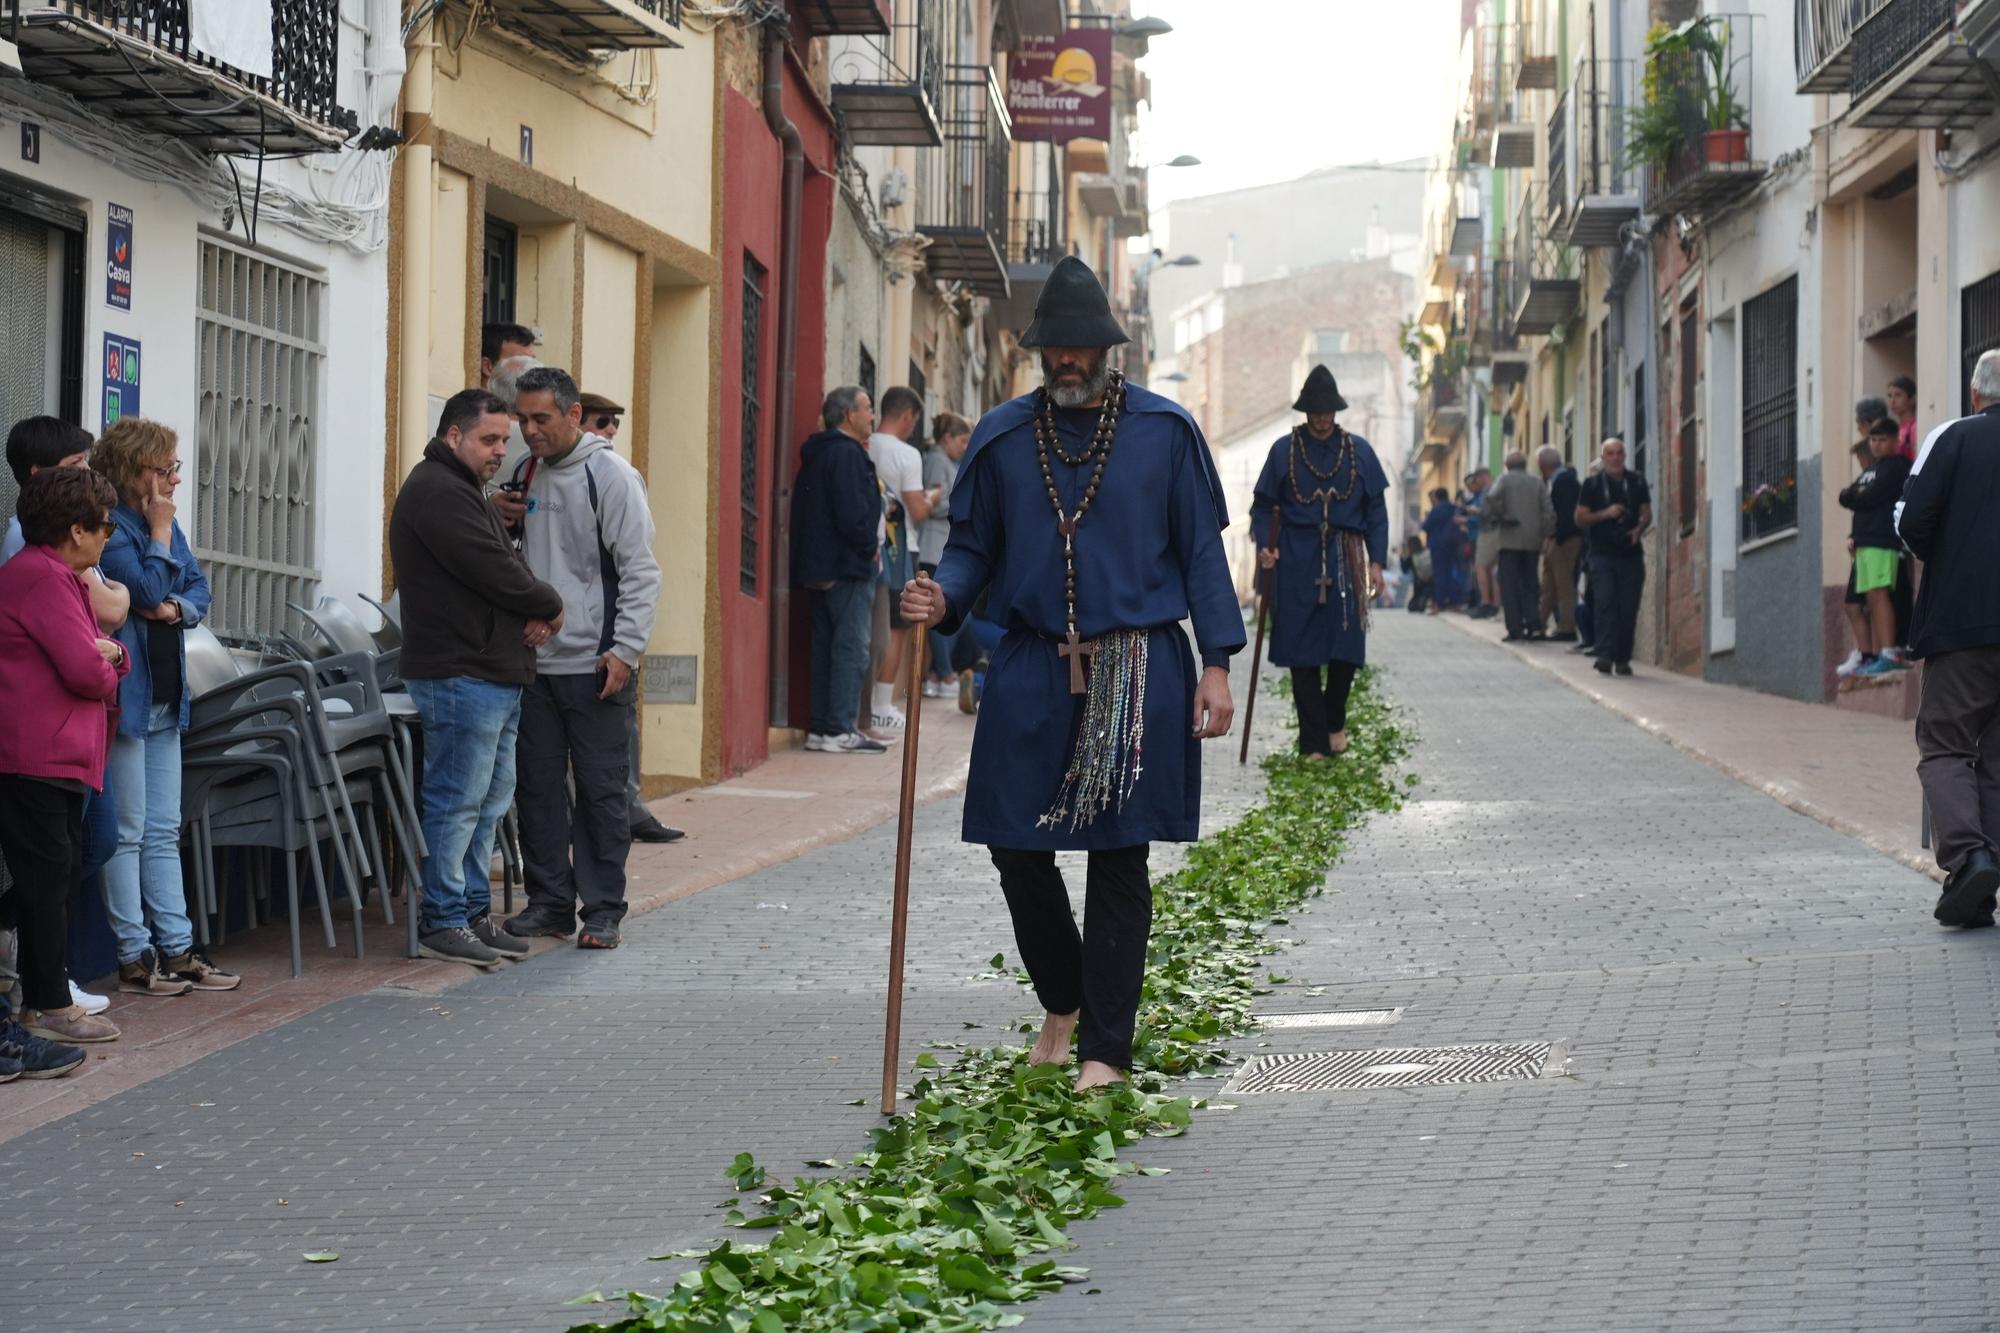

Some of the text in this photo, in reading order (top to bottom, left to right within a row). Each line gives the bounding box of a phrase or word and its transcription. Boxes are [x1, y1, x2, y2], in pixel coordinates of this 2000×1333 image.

[1009, 79, 1044, 95] Valls
[524, 130, 534, 162] 7
[109, 206, 132, 224] ALARMA
[108, 261, 130, 284] Casva
